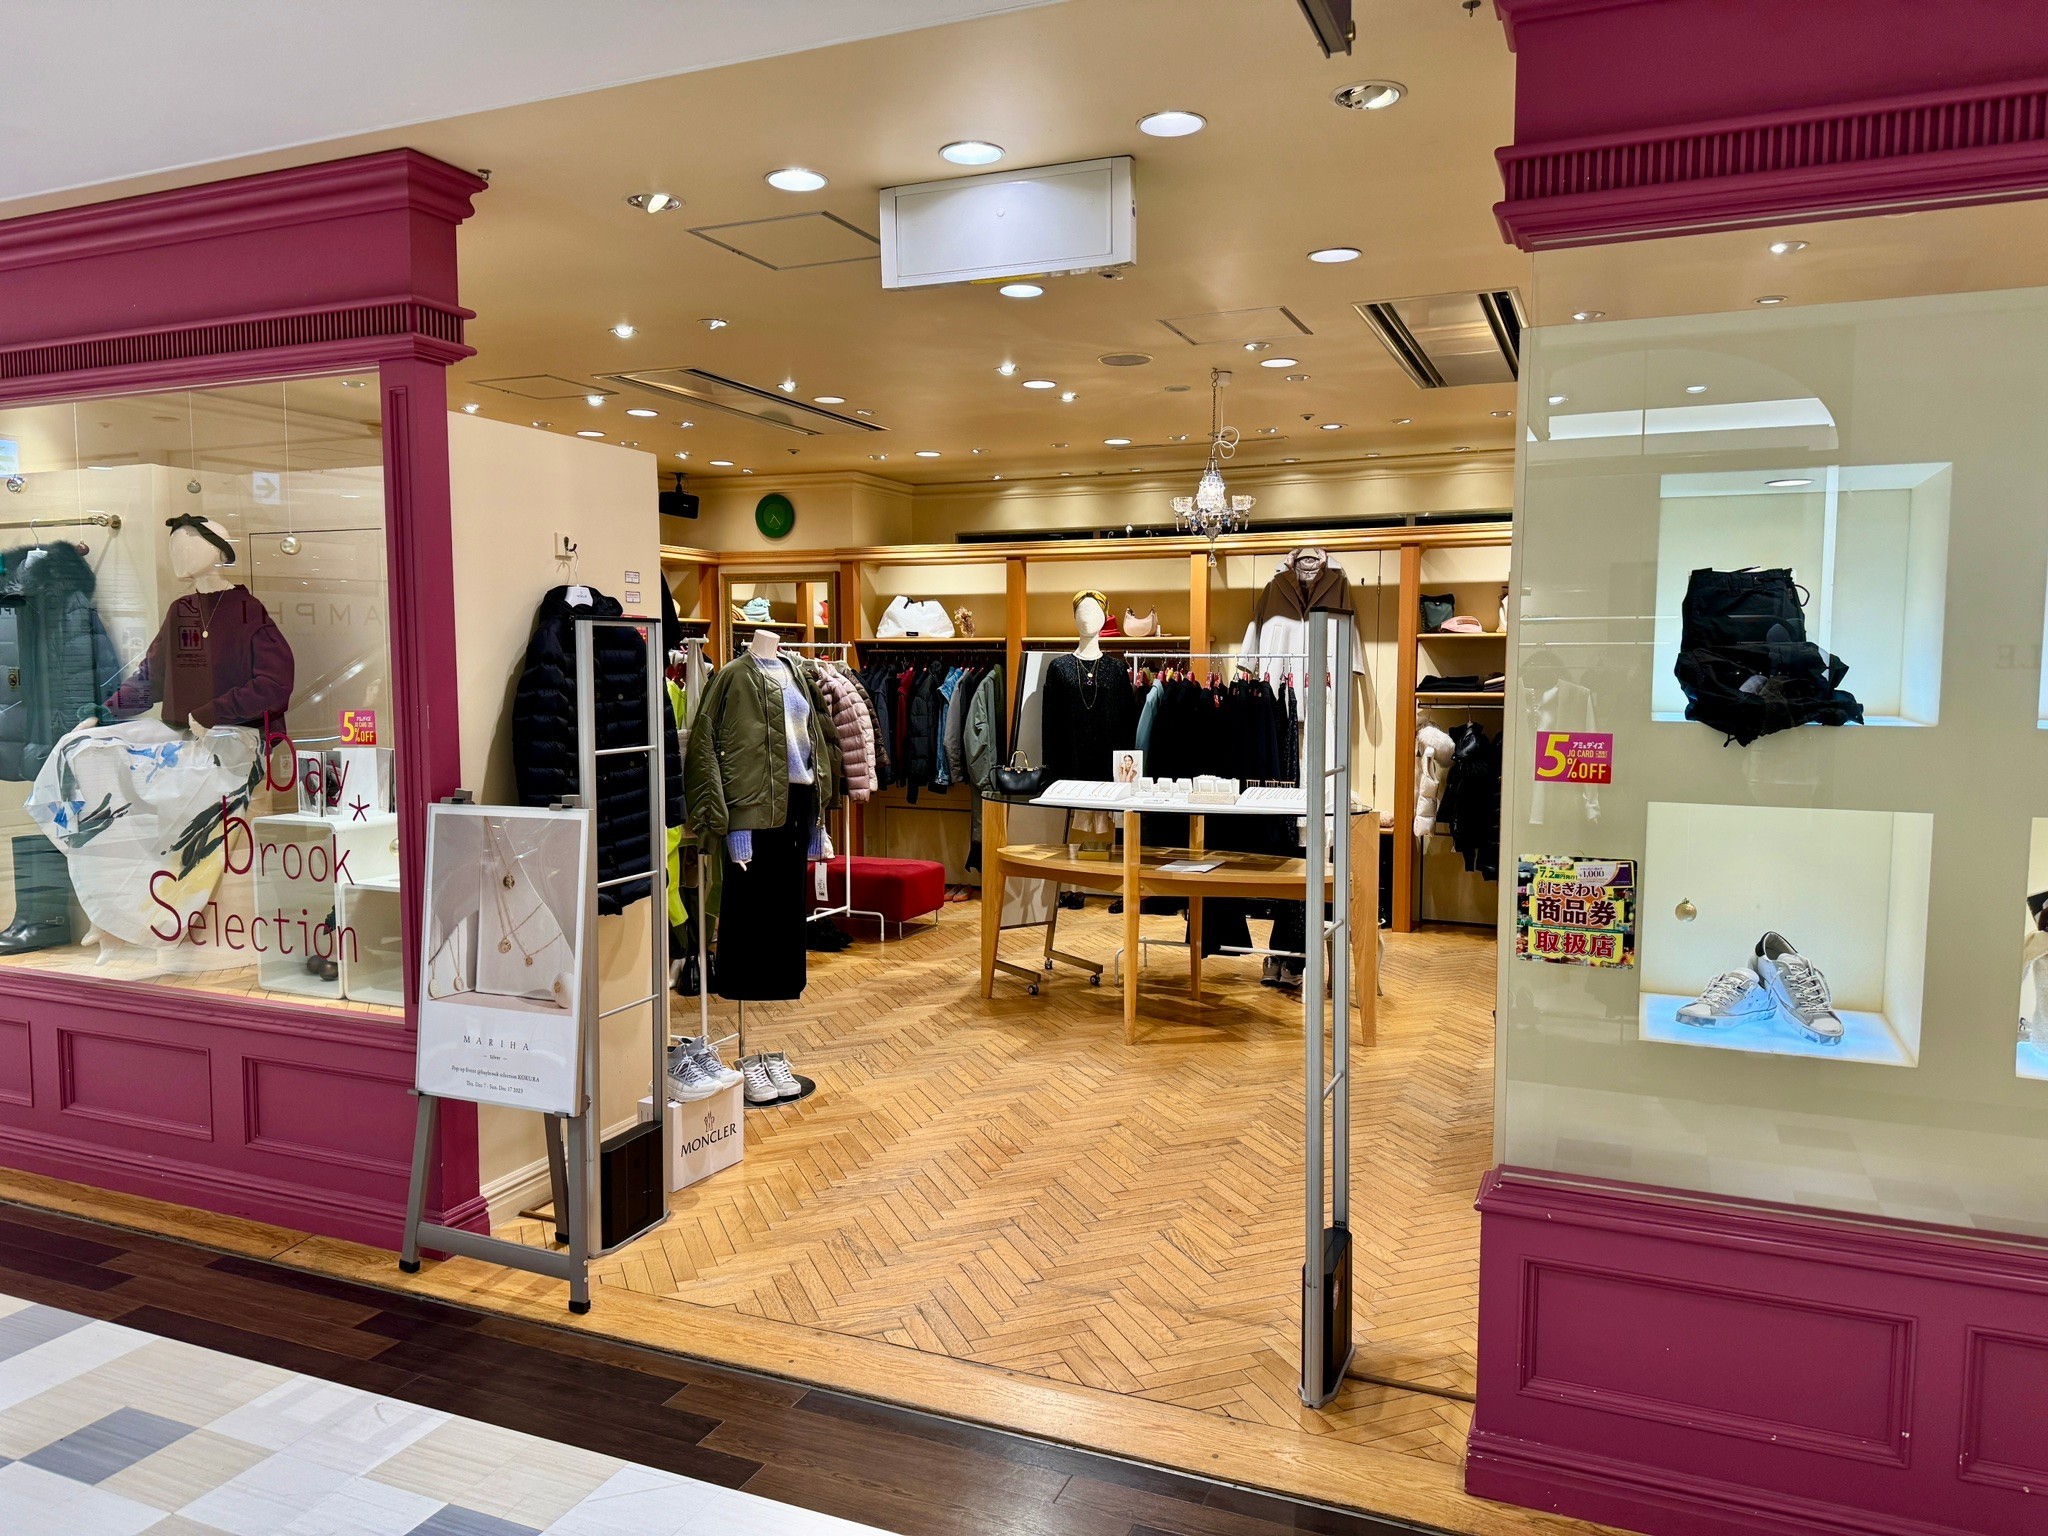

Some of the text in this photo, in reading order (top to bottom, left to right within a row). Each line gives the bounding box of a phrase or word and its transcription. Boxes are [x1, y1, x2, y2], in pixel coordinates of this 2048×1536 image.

[341, 711, 355, 742] 5
[263, 710, 350, 806] bay
[1536, 733, 1570, 778] 5
[1577, 750, 1594, 758] CARD
[222, 795, 355, 885] brook
[1547, 881, 1606, 898] にぎわい
[149, 870, 358, 963] Selection
[1537, 898, 1617, 926] 商品券
[1535, 929, 1616, 958] 取扱店
[463, 1035, 529, 1051] MARIHA
[517, 1074, 540, 1083] KOKURA
[680, 1122, 737, 1157] MONCLER
